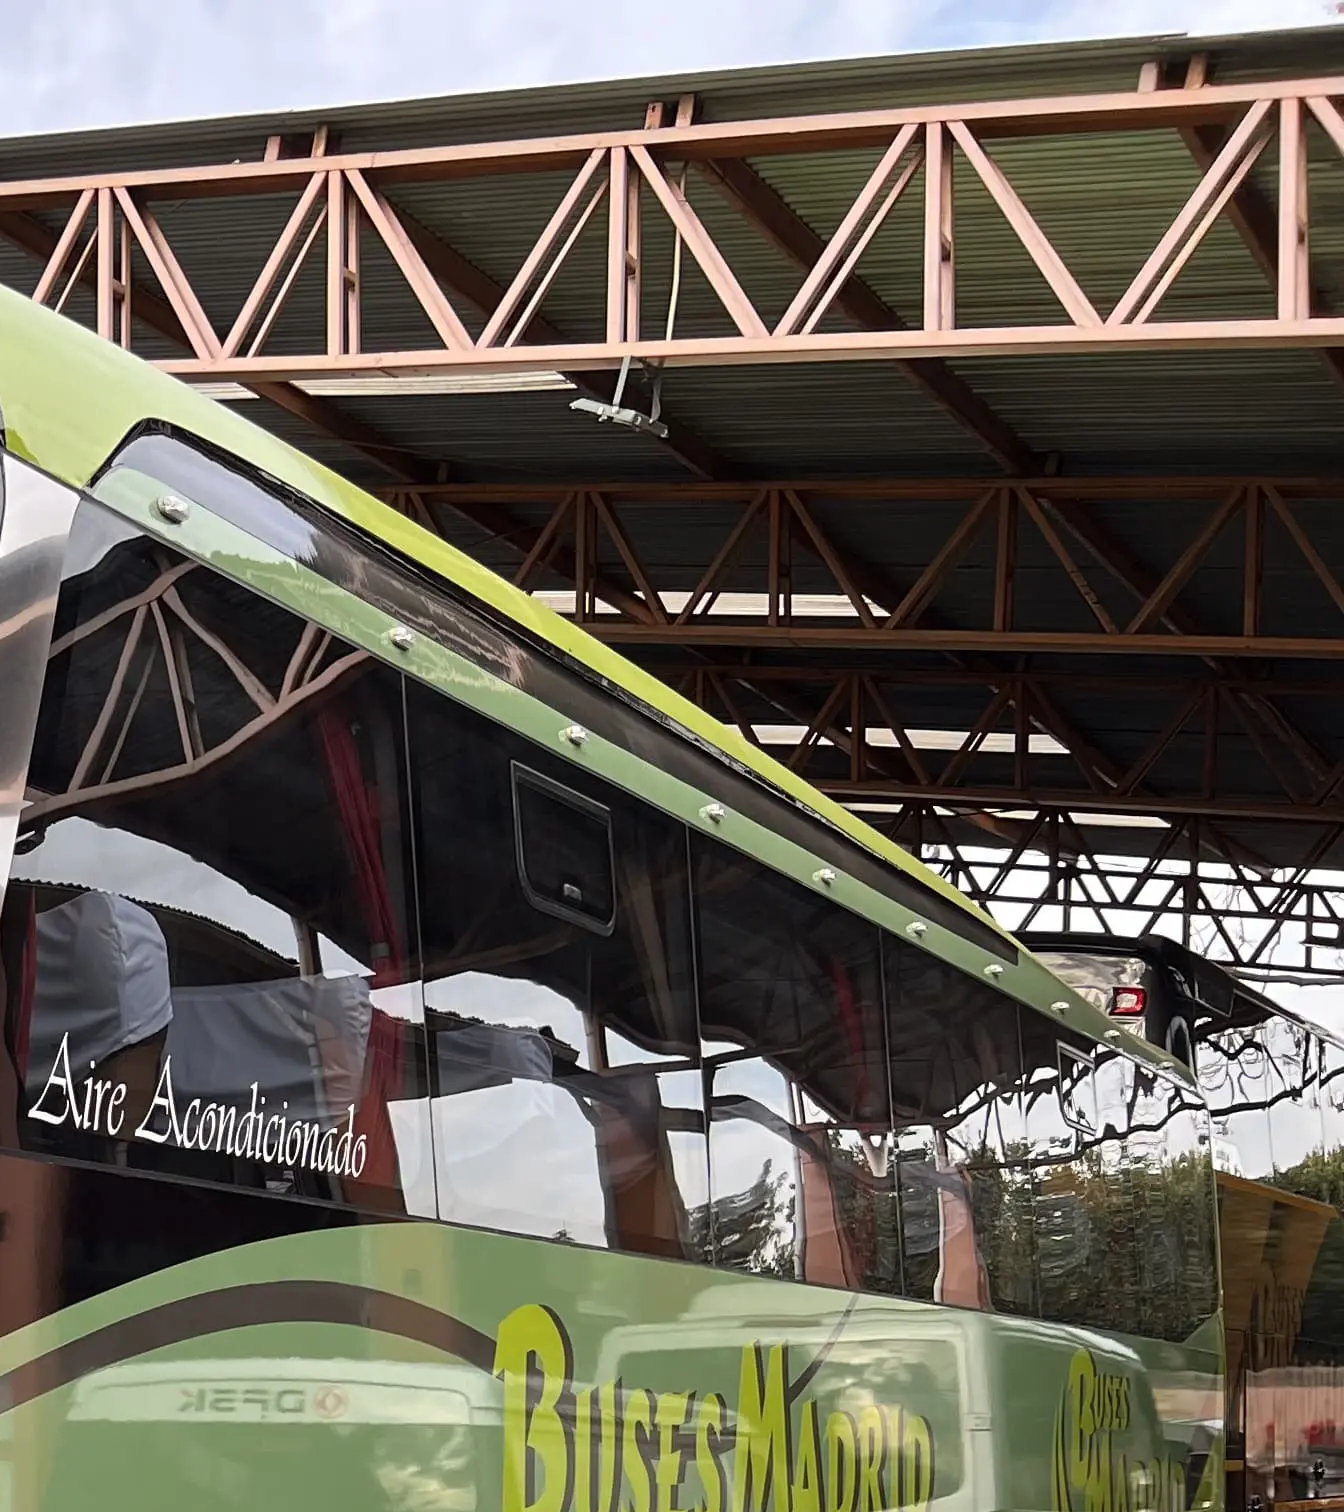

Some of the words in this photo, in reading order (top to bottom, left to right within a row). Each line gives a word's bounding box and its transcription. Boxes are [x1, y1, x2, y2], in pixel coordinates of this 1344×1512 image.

[27, 1031, 128, 1136] Aire
[134, 1054, 367, 1178] Acondicionado
[1068, 1346, 1131, 1489] BUSES
